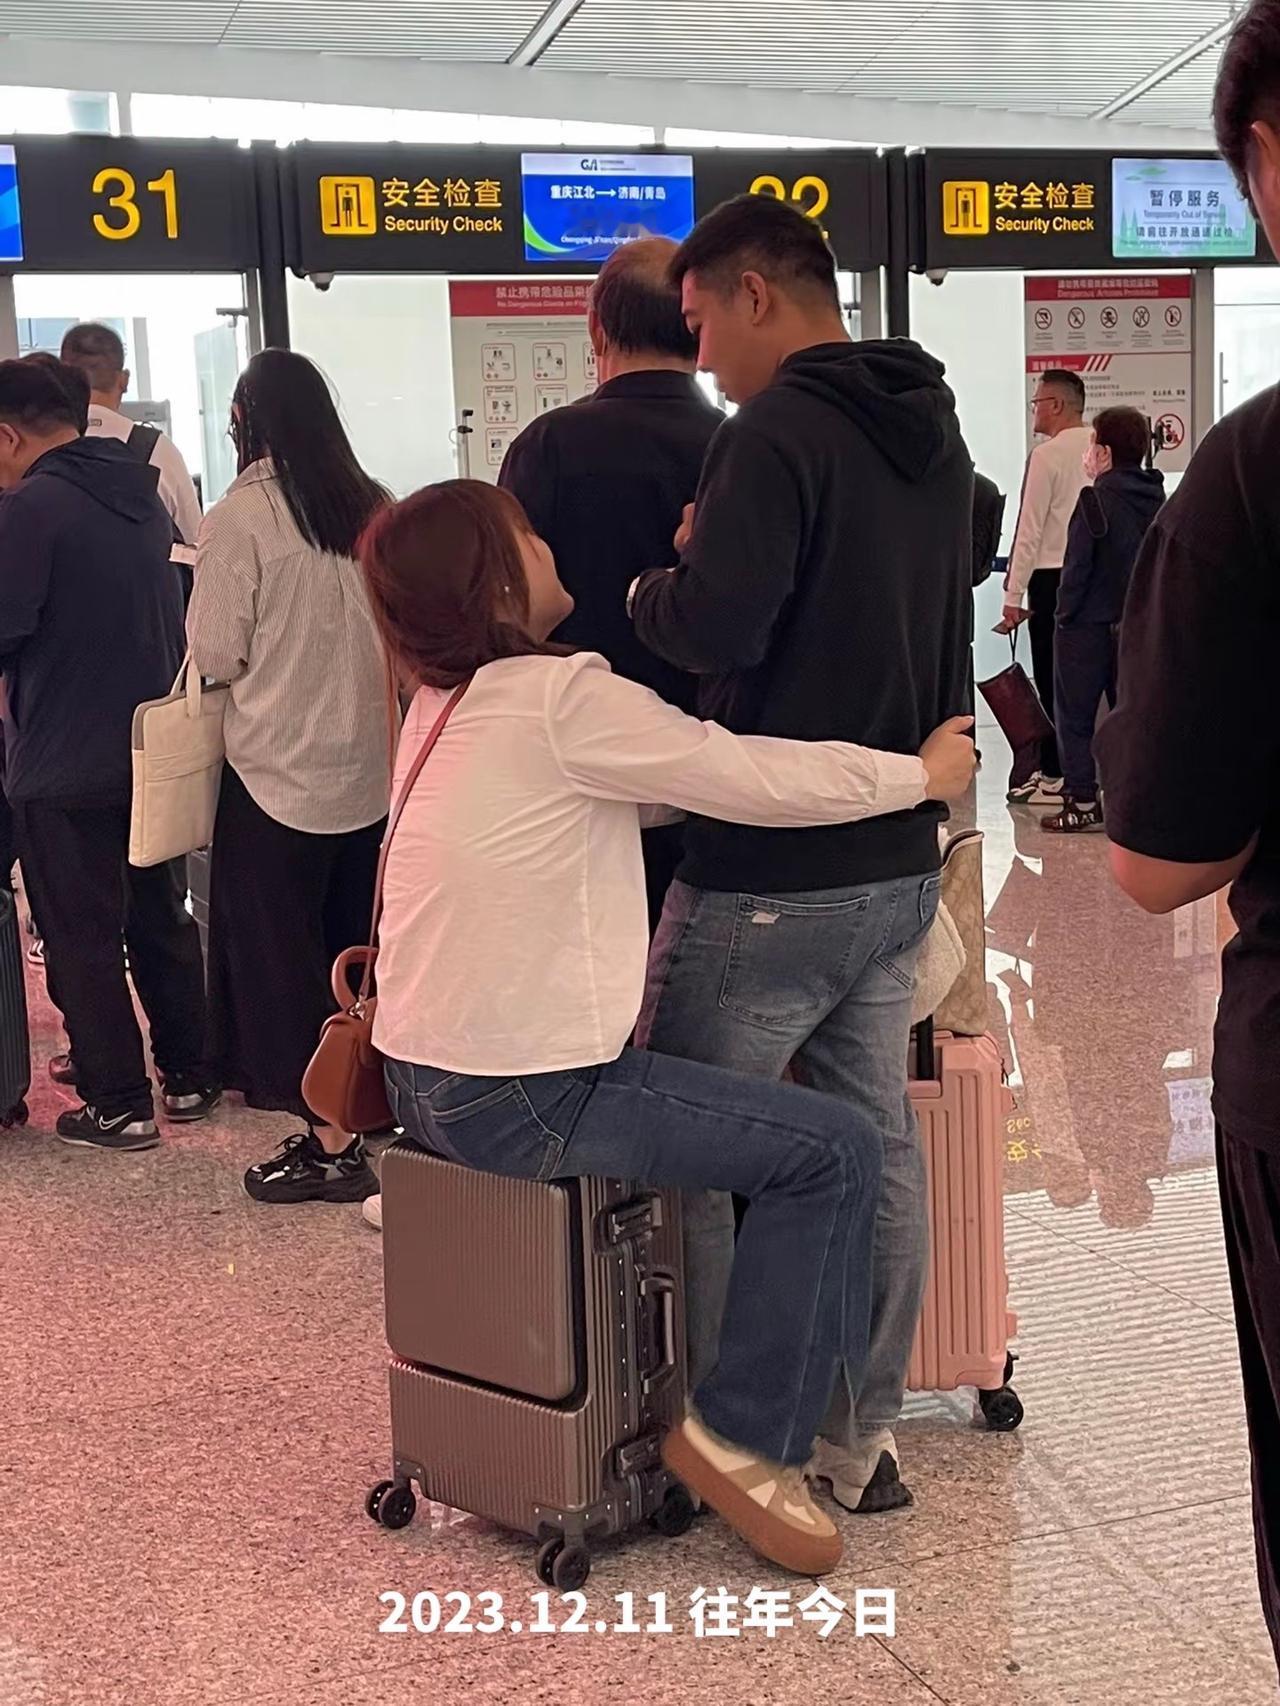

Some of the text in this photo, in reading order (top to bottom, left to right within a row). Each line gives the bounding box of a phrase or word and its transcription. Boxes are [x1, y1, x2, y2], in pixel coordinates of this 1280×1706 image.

[91, 167, 179, 240] 31
[381, 178, 503, 207] 安全检查
[994, 182, 1096, 210] 安全检查
[1150, 189, 1220, 207] 暂停服务
[384, 215, 503, 235] Security Check
[995, 216, 1095, 234] Security Check
